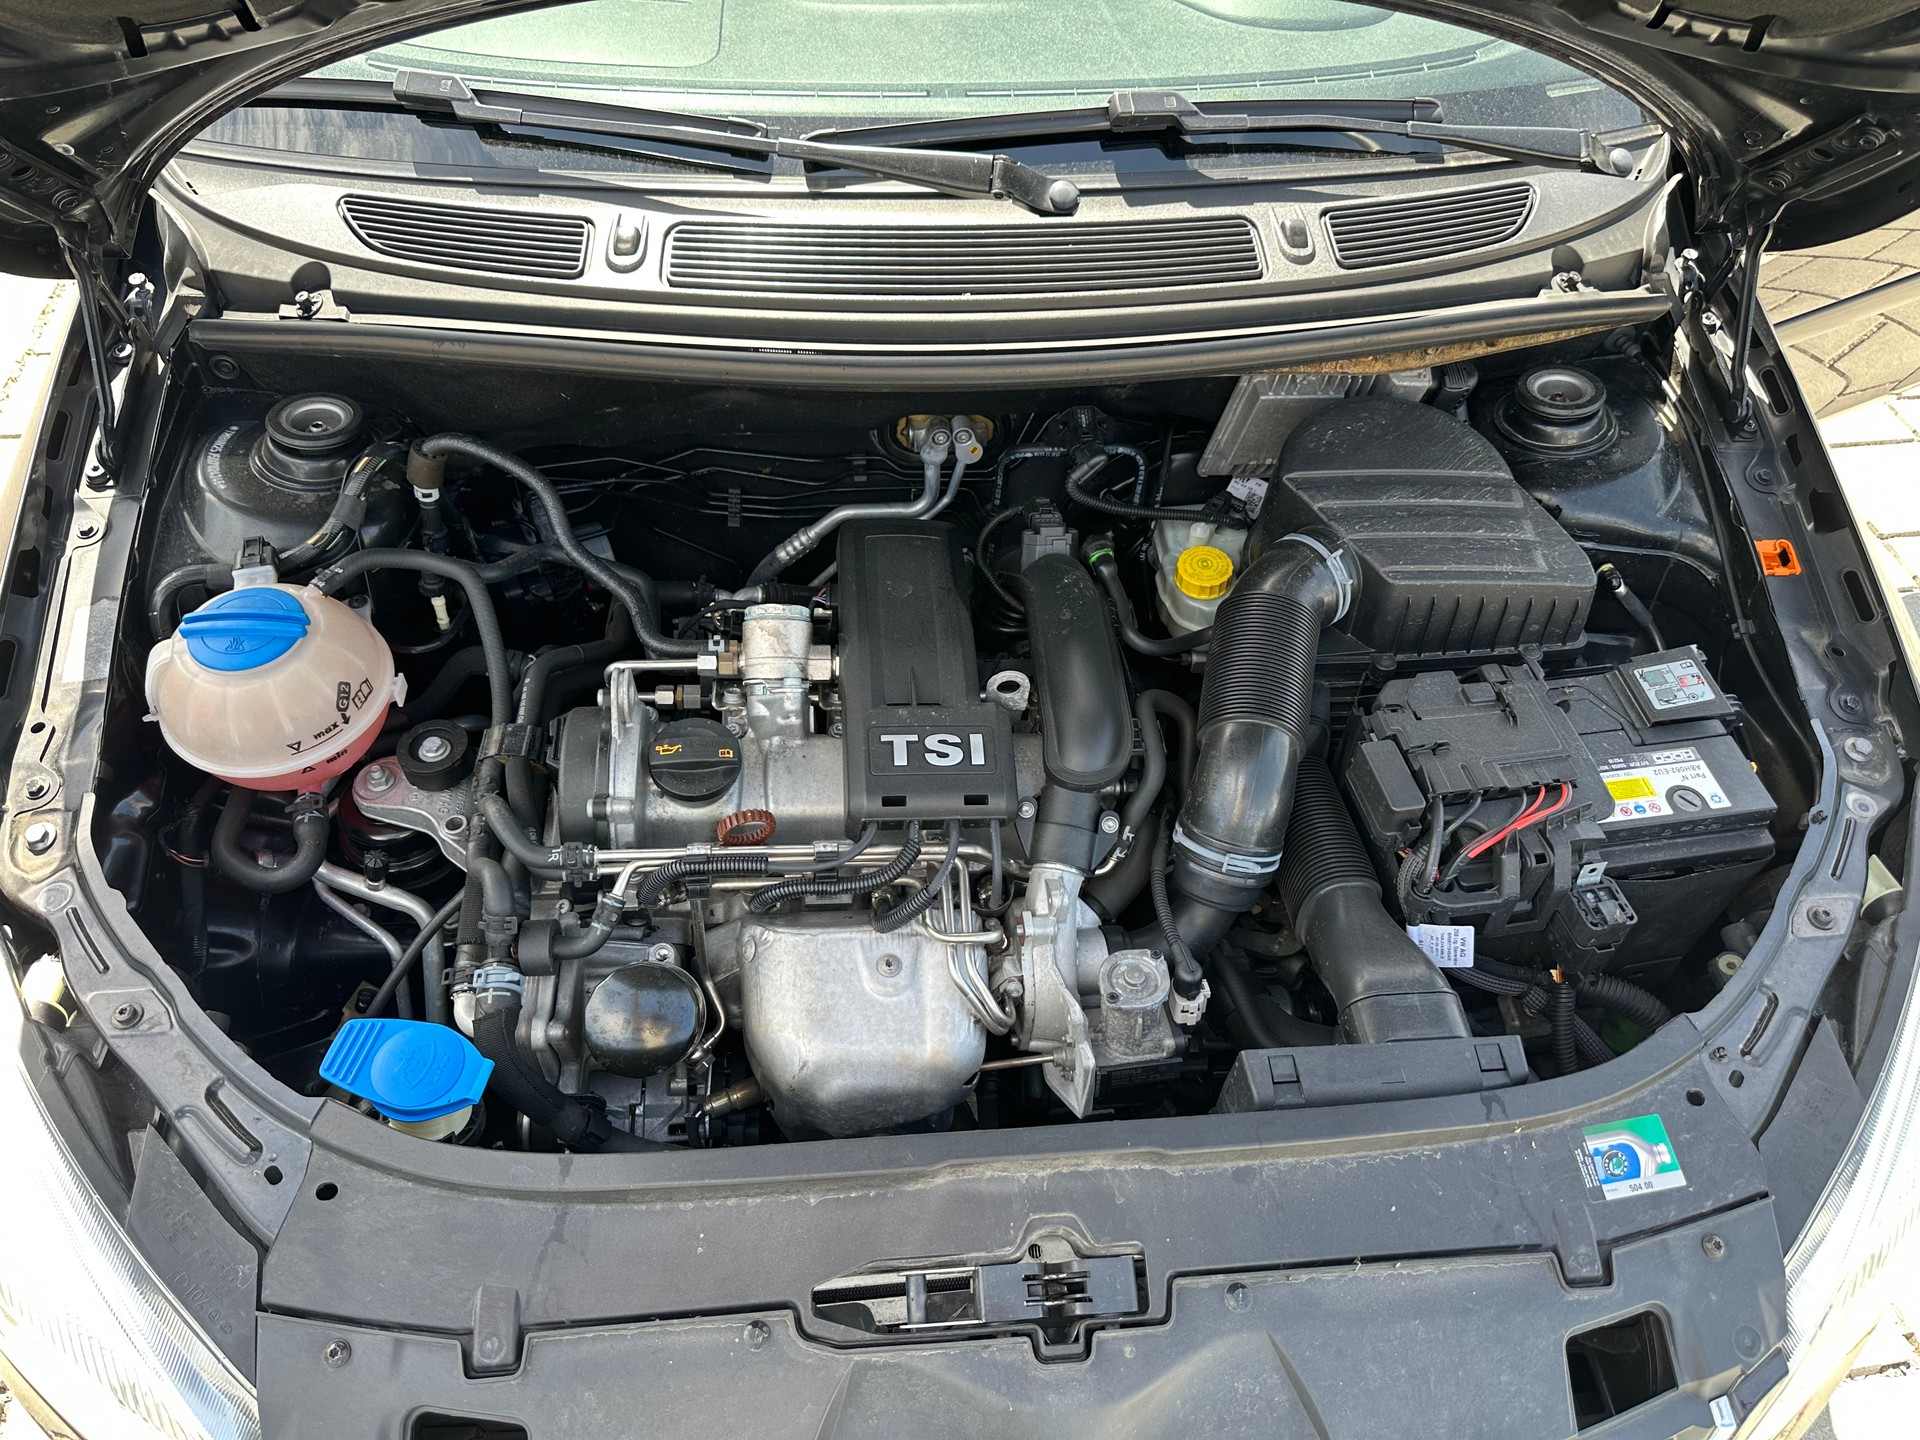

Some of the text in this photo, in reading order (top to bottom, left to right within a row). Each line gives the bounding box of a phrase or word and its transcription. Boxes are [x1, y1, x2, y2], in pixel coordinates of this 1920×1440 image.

[339, 683, 349, 709] G12
[313, 720, 341, 741] max
[326, 748, 349, 764] min
[880, 733, 986, 767] TSI
[1691, 772, 1707, 780] Part
[1460, 936, 1467, 958] VW AG
[1628, 1183, 1643, 1193] 504
[1643, 1180, 1654, 1190] 00
